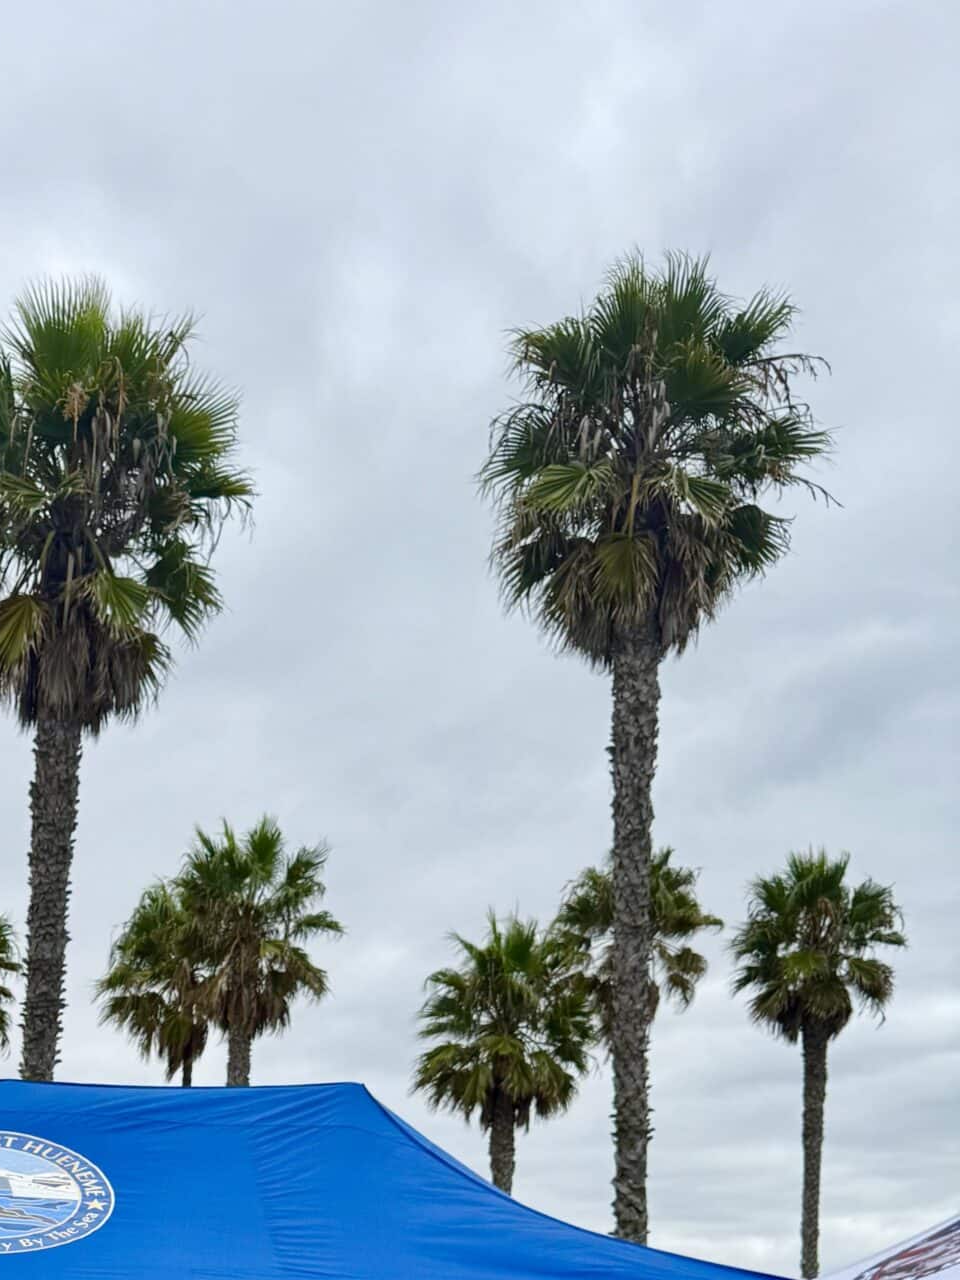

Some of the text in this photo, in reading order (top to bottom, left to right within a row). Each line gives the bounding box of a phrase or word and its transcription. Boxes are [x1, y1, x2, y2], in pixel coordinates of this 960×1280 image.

[21, 1140, 107, 1198] HUENEME
[19, 1237, 44, 1250] By
[47, 1226, 78, 1243] The
[76, 1211, 100, 1231] Sea
